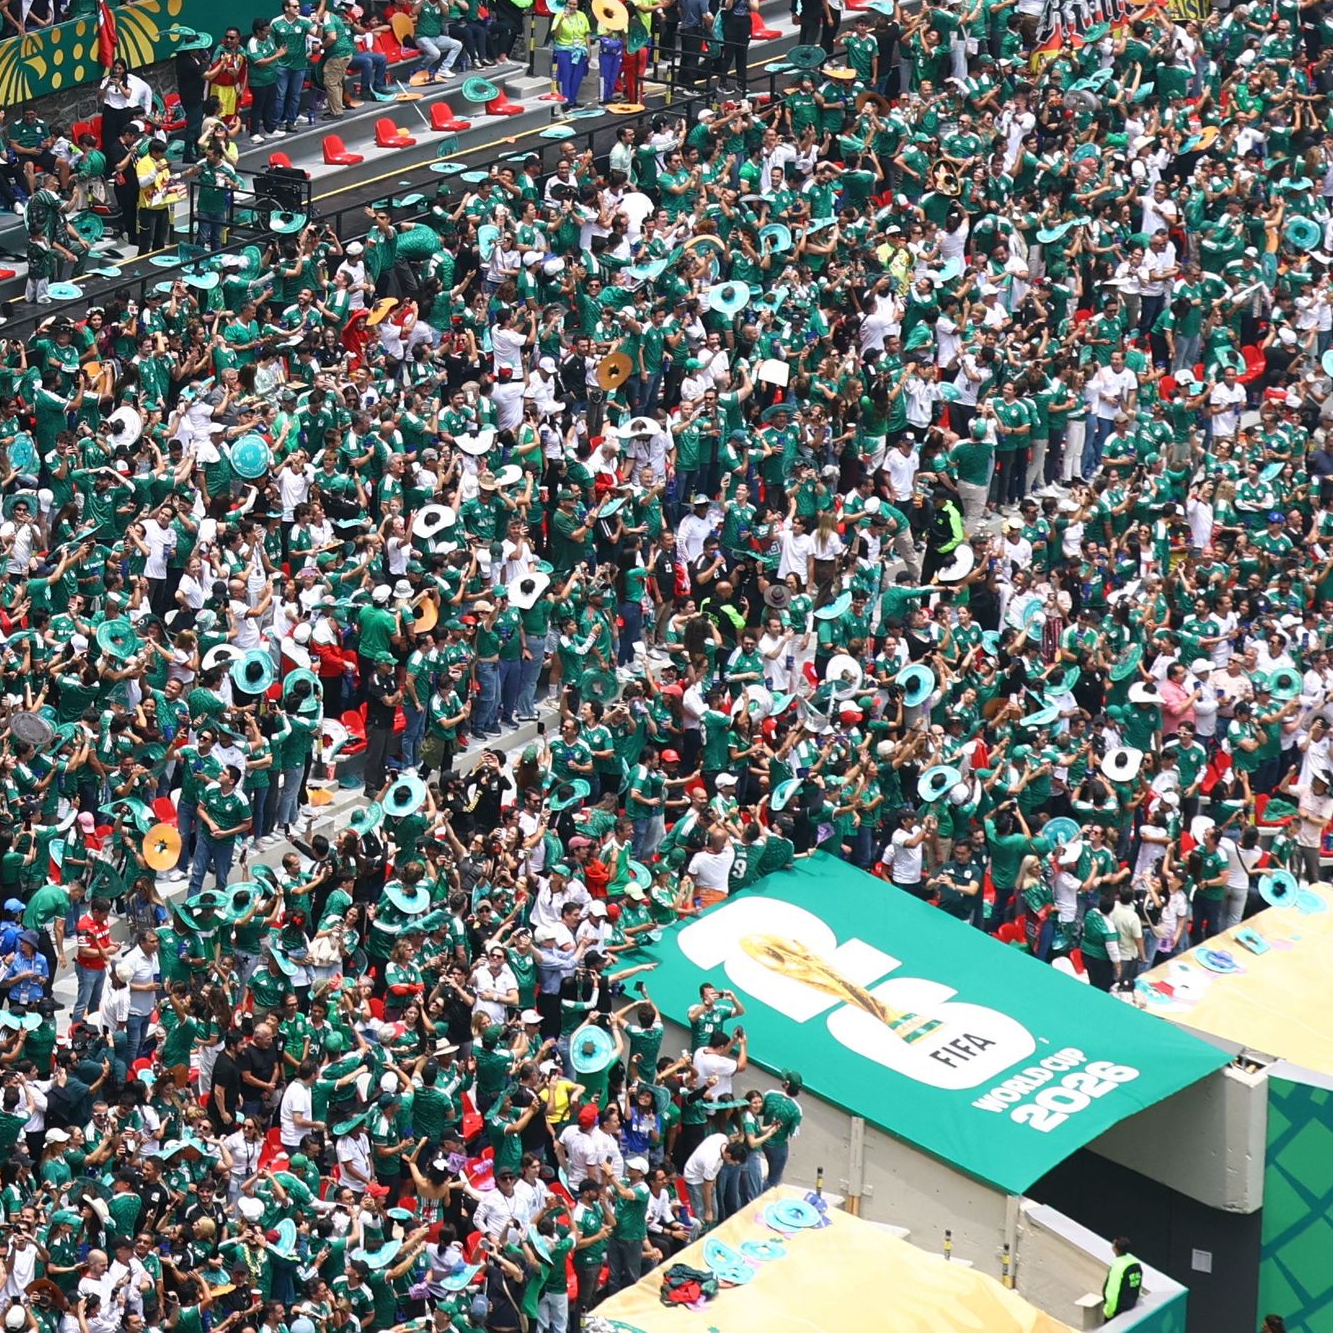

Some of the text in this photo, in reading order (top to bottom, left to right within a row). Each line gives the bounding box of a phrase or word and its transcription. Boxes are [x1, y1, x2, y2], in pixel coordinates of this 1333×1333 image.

[927, 1032, 998, 1069] FIFA
[972, 1047, 1088, 1113] WORLD CUP
[1011, 1061, 1140, 1133] 2026
